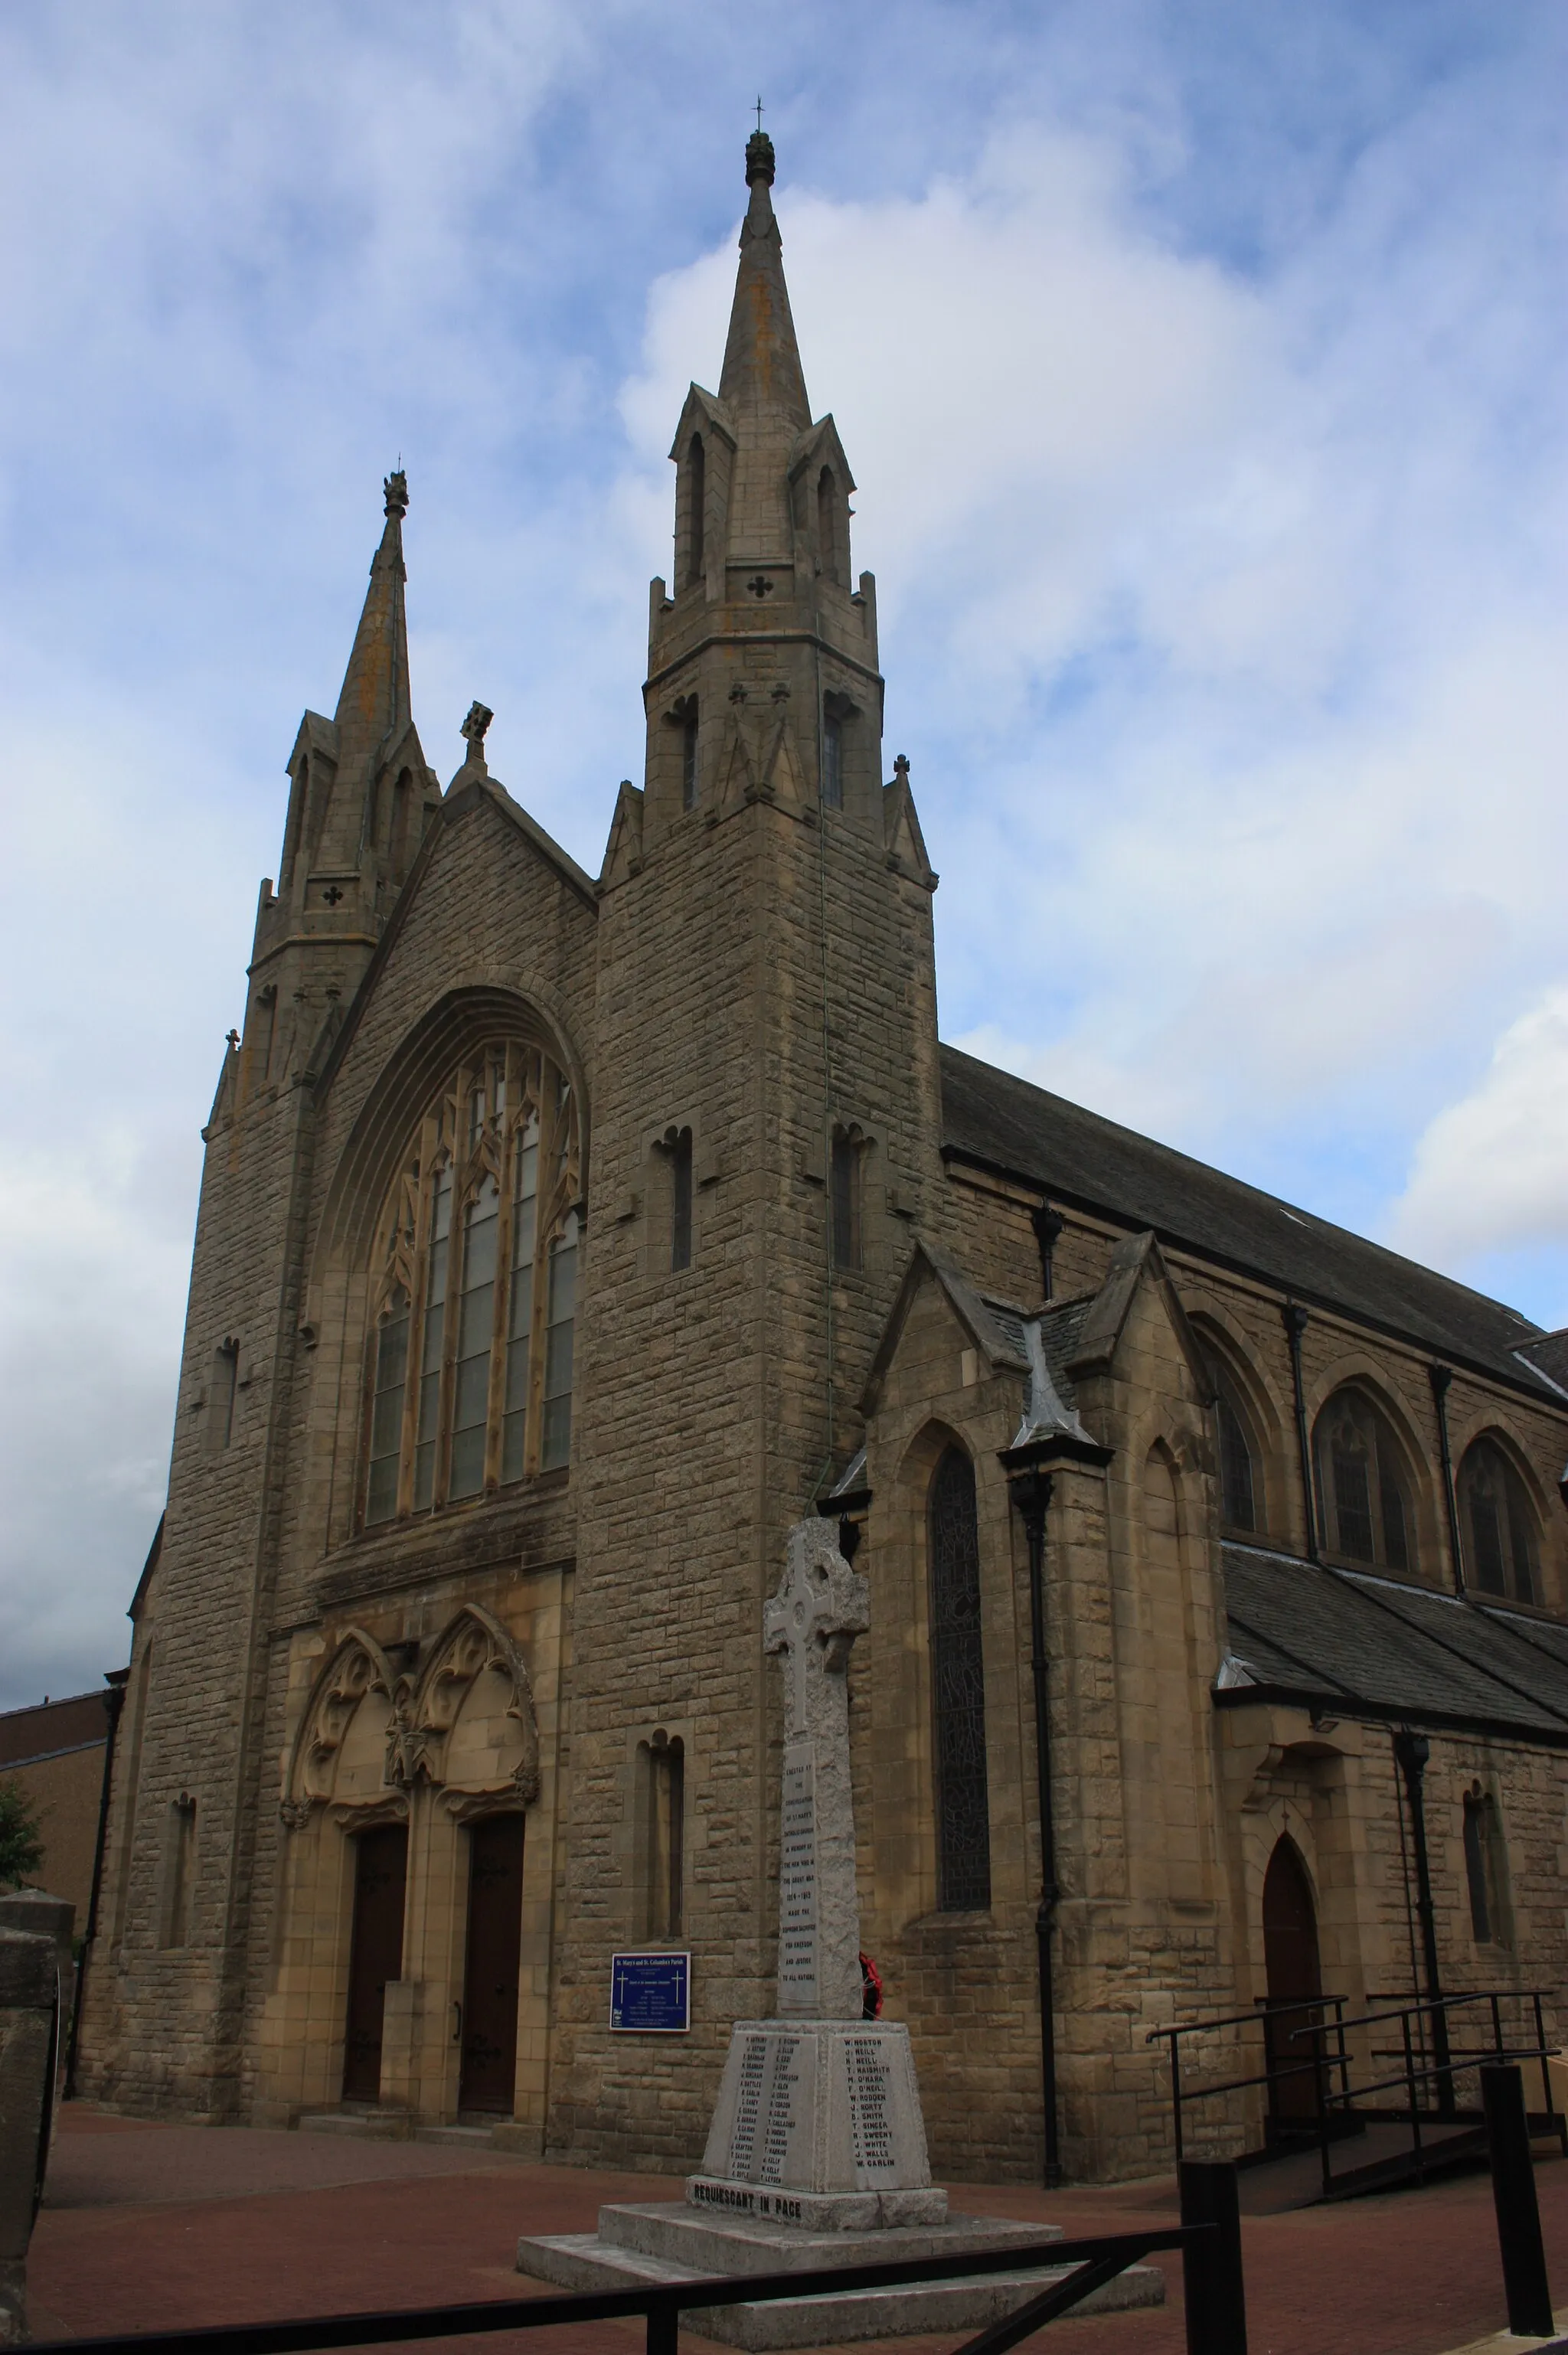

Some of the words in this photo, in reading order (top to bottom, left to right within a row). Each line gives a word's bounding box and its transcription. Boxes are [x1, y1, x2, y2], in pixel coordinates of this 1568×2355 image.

[694, 2183, 753, 2209] REQUIESCANT
[760, 2195, 769, 2213] IN
[776, 2197, 801, 2218] PACE
